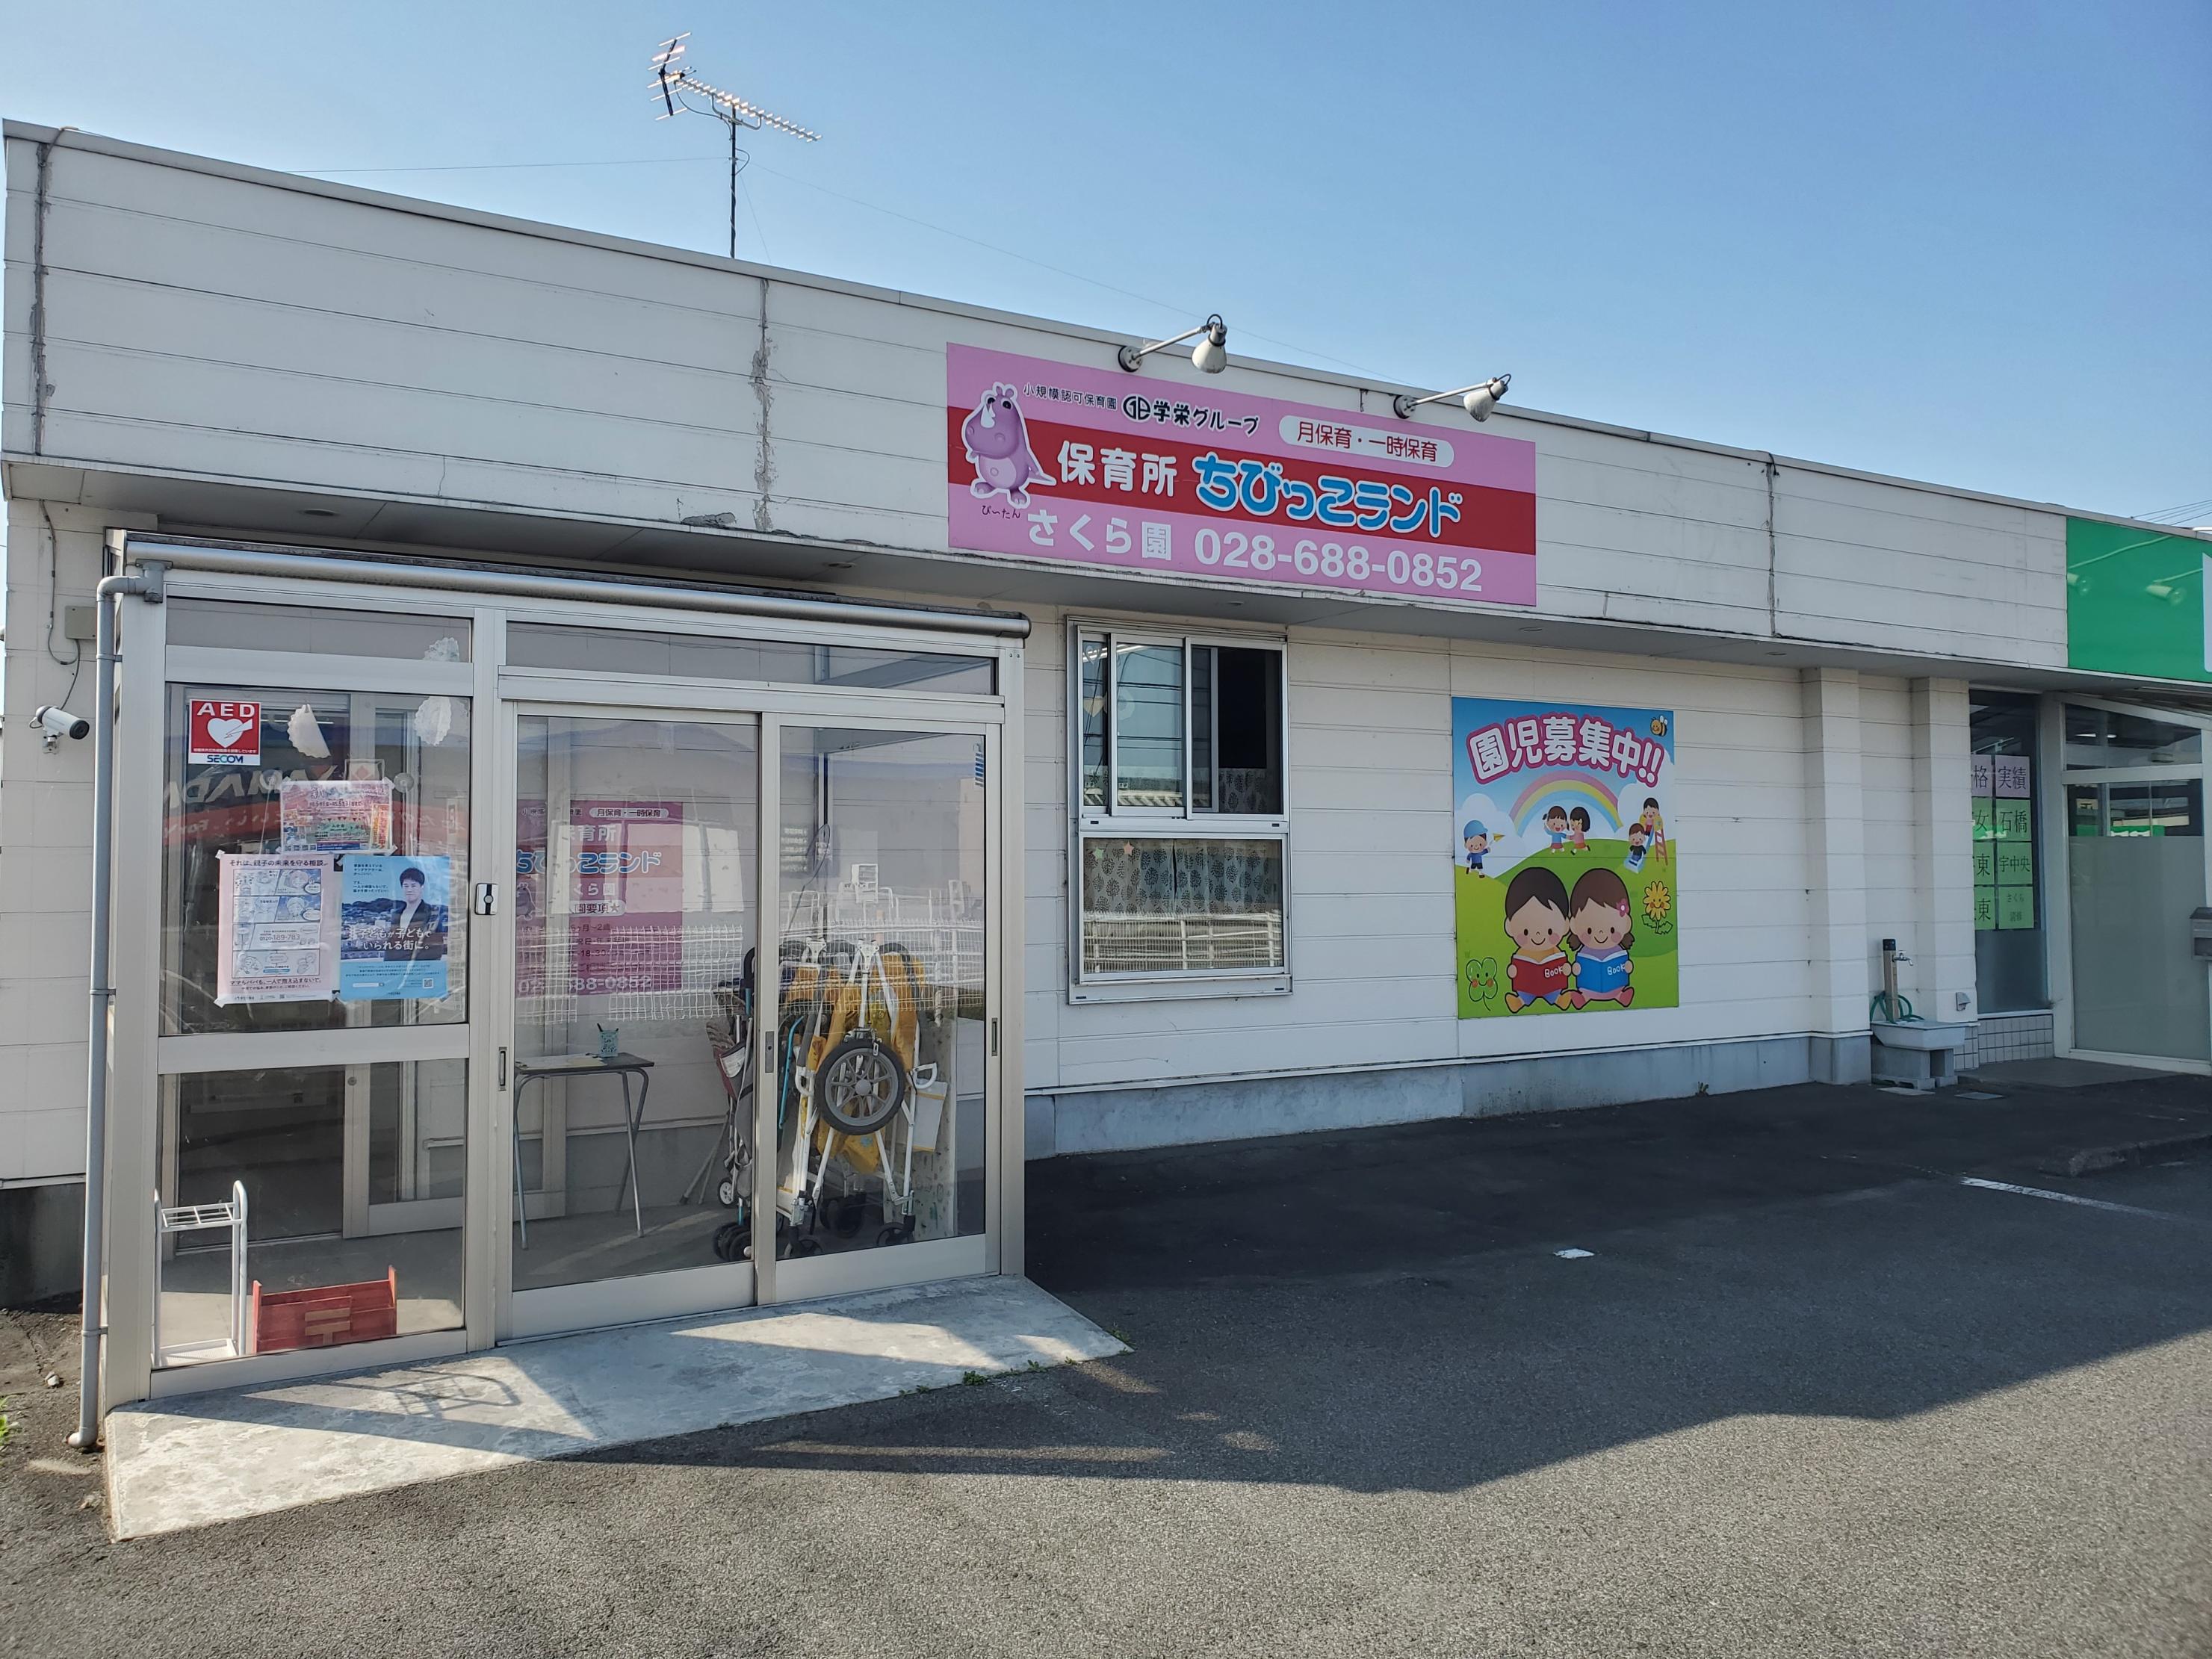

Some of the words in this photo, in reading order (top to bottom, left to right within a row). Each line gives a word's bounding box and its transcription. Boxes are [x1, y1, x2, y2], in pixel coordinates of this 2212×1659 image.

[1023, 382, 1118, 410] 小規模認可保育園
[1153, 400, 1260, 436] 学栄グループ
[1297, 421, 1438, 462] 月保育・一時保育
[1058, 440, 1177, 498] 保育所
[1192, 451, 1463, 537] ちびっこランド
[1027, 509, 1172, 561] さくら園
[1195, 528, 1482, 592] 028-688-0852
[196, 702, 255, 717] AED
[206, 754, 244, 763] SECOM
[1468, 715, 1664, 785] 園児募集中!!
[1971, 765, 1988, 789] 格
[1998, 766, 2027, 790] 実績
[1972, 810, 1989, 831] 女
[2000, 810, 2027, 833] 石橋
[516, 849, 662, 875] ちこランド
[1972, 853, 1990, 877] 東
[1974, 898, 1991, 922] 東
